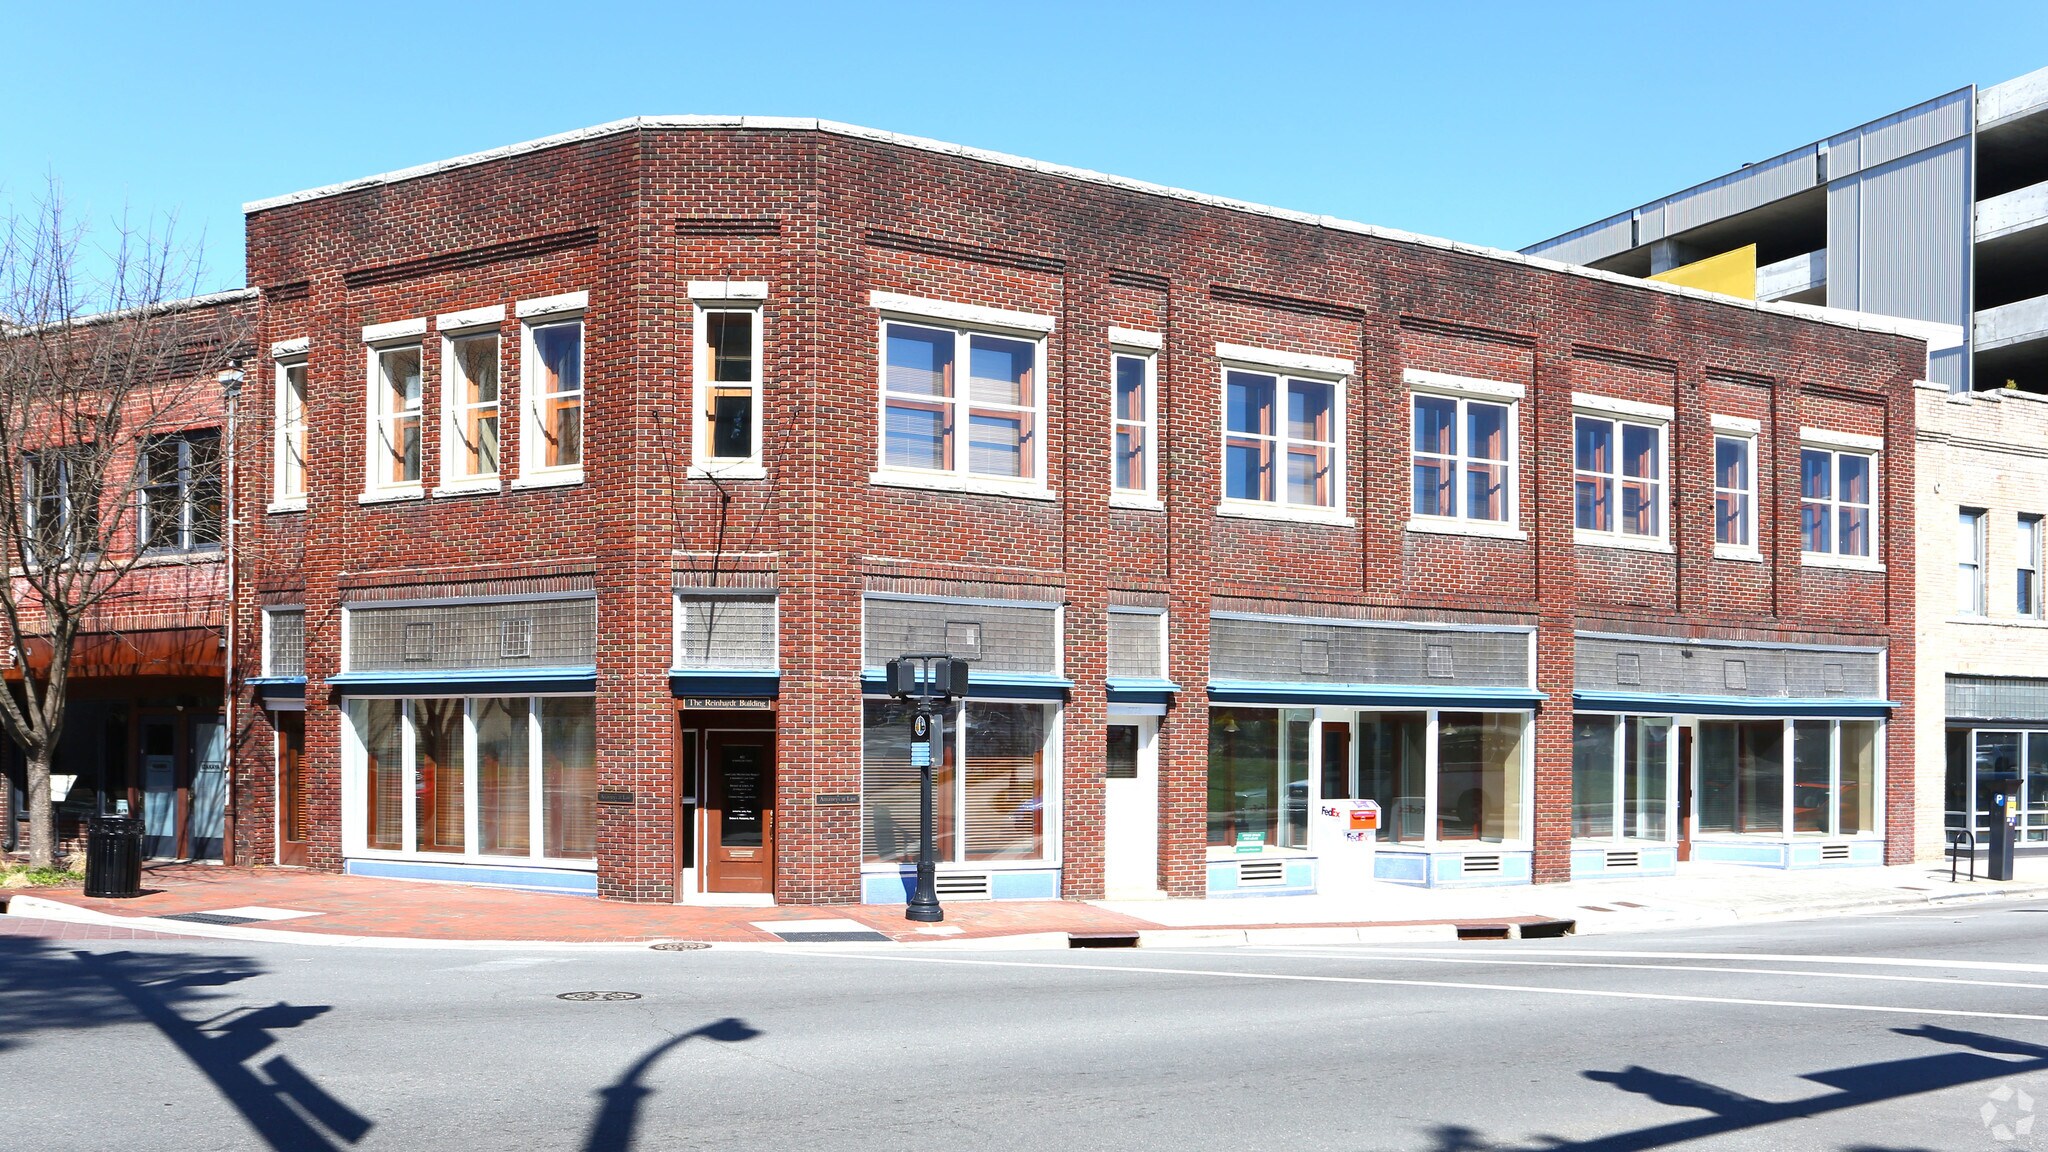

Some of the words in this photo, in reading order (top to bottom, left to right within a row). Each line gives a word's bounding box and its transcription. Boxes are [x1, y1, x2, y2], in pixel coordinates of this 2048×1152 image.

[688, 698, 702, 707] The
[705, 698, 736, 707] Reinhardt
[740, 698, 766, 708] Building
[1321, 806, 1340, 817] FedEx
